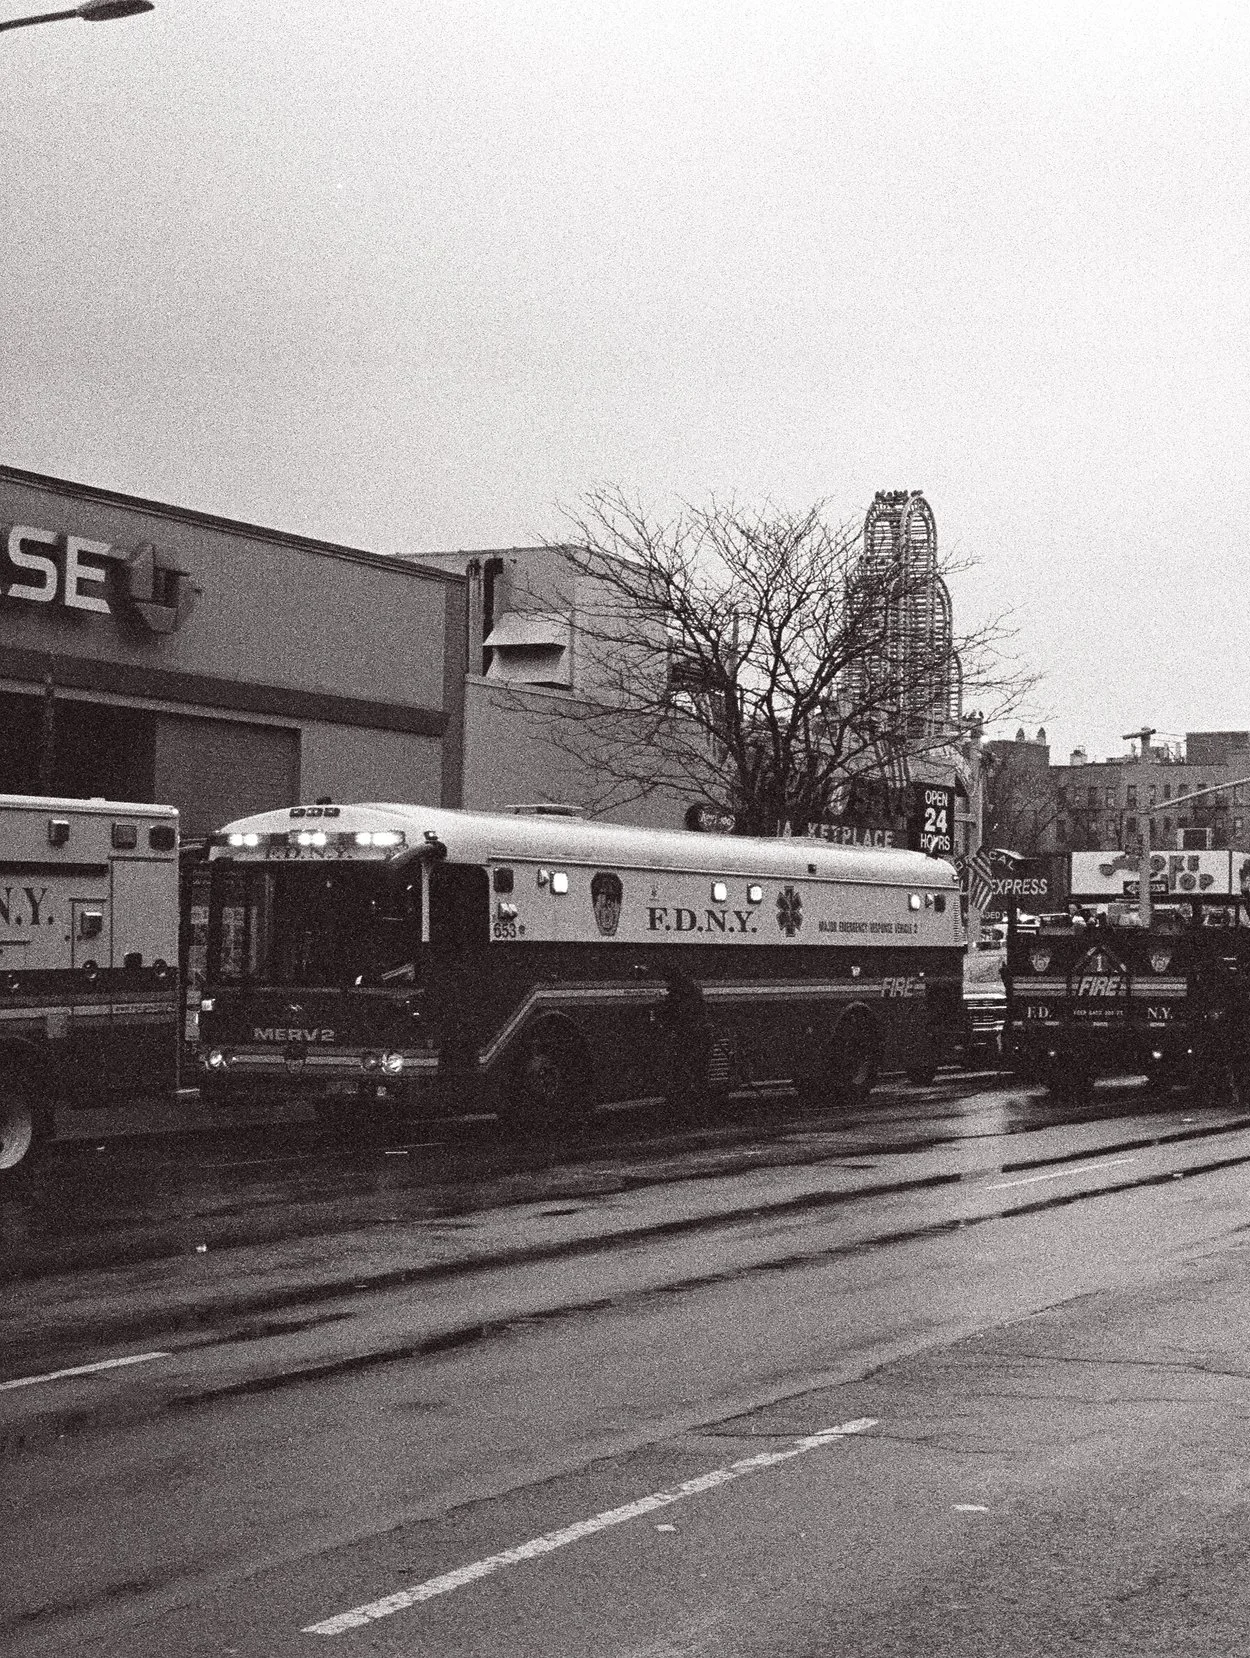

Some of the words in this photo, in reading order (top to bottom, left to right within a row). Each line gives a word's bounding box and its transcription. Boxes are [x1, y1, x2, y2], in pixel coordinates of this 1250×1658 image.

[0, 525, 112, 614] SE
[925, 790, 948, 807] OPEN
[924, 807, 948, 833] 24
[920, 833, 951, 851] HORS
[991, 879, 1048, 895] EXPRESS
[646, 907, 757, 933] F.D.N.Y.
[493, 922, 517, 938] 653
[881, 977, 917, 998] FIRE
[1077, 976, 1121, 997] FIRE
[1026, 1006, 1052, 1019] F.D.
[1147, 1007, 1174, 1020] N.Y.
